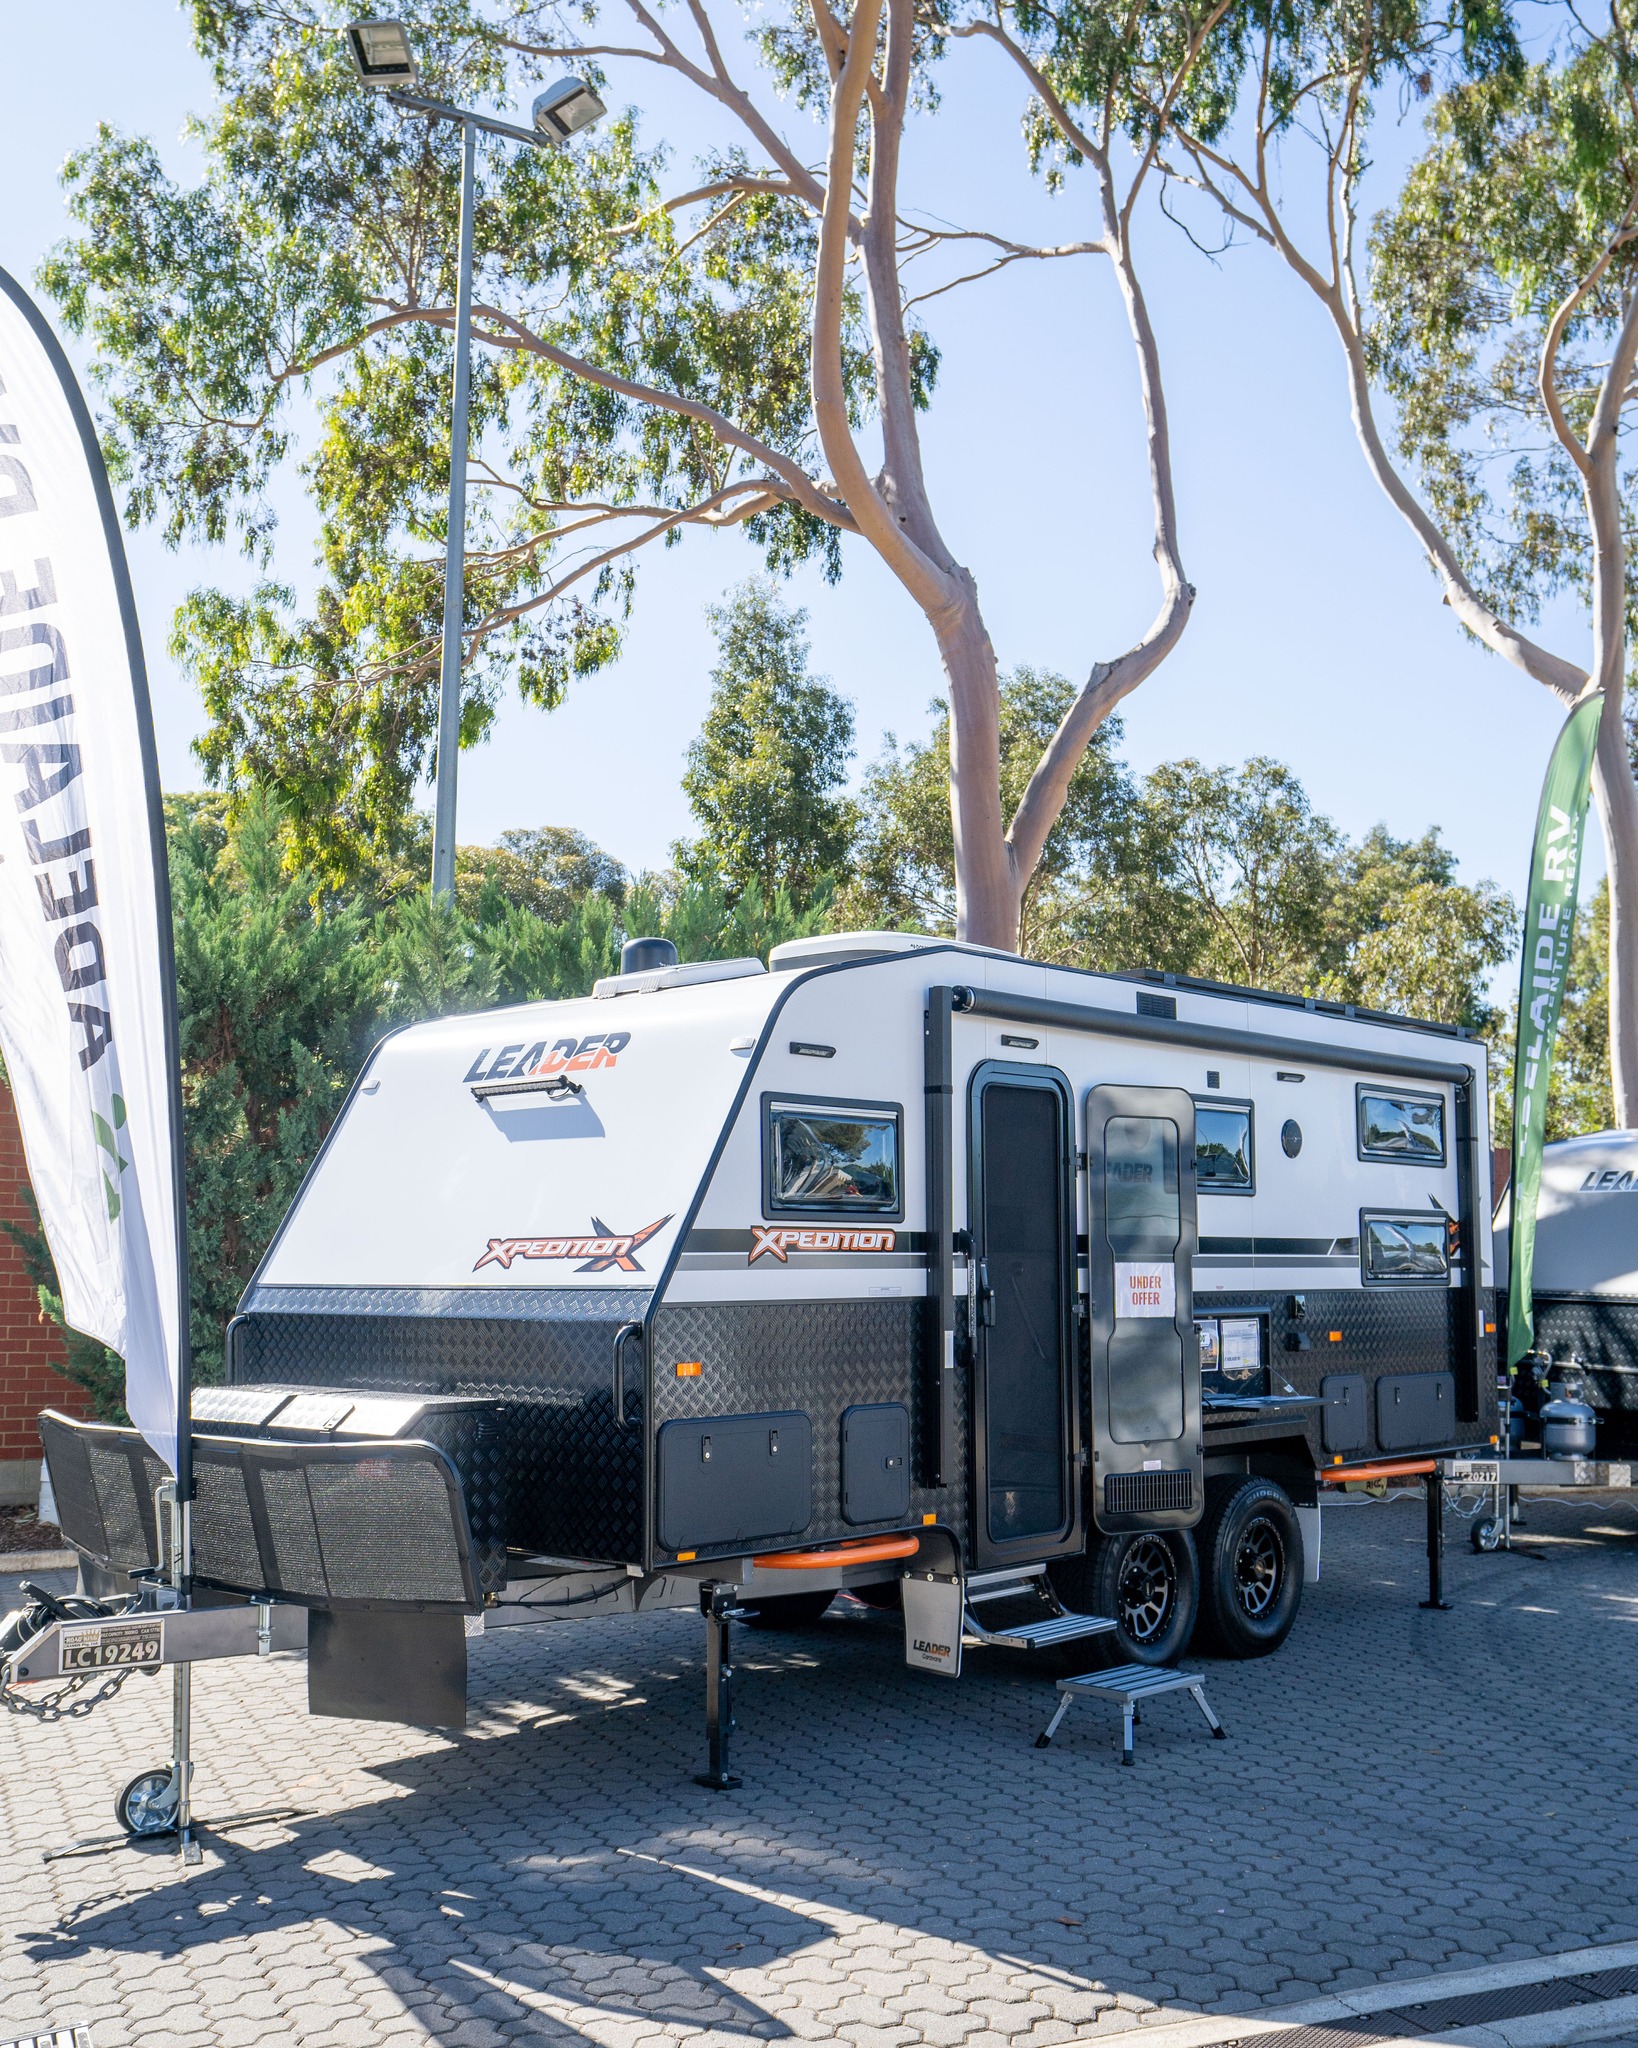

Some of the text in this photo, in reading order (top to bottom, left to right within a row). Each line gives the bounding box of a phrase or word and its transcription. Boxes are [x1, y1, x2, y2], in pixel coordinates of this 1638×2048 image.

[1543, 804, 1573, 882] RV
[462, 1031, 632, 1083] LEADER
[1579, 1170, 1638, 1191] LEA
[472, 1236, 635, 1272] XPEDITION
[748, 1226, 896, 1266] XPEDITION
[1130, 1275, 1162, 1289] UNDER
[1132, 1292, 1160, 1305] OFFER
[66, 1636, 83, 1644] ROAD
[84, 1634, 98, 1642] KING
[913, 1639, 951, 1657] LEADER
[65, 1641, 158, 1668] LC19249
